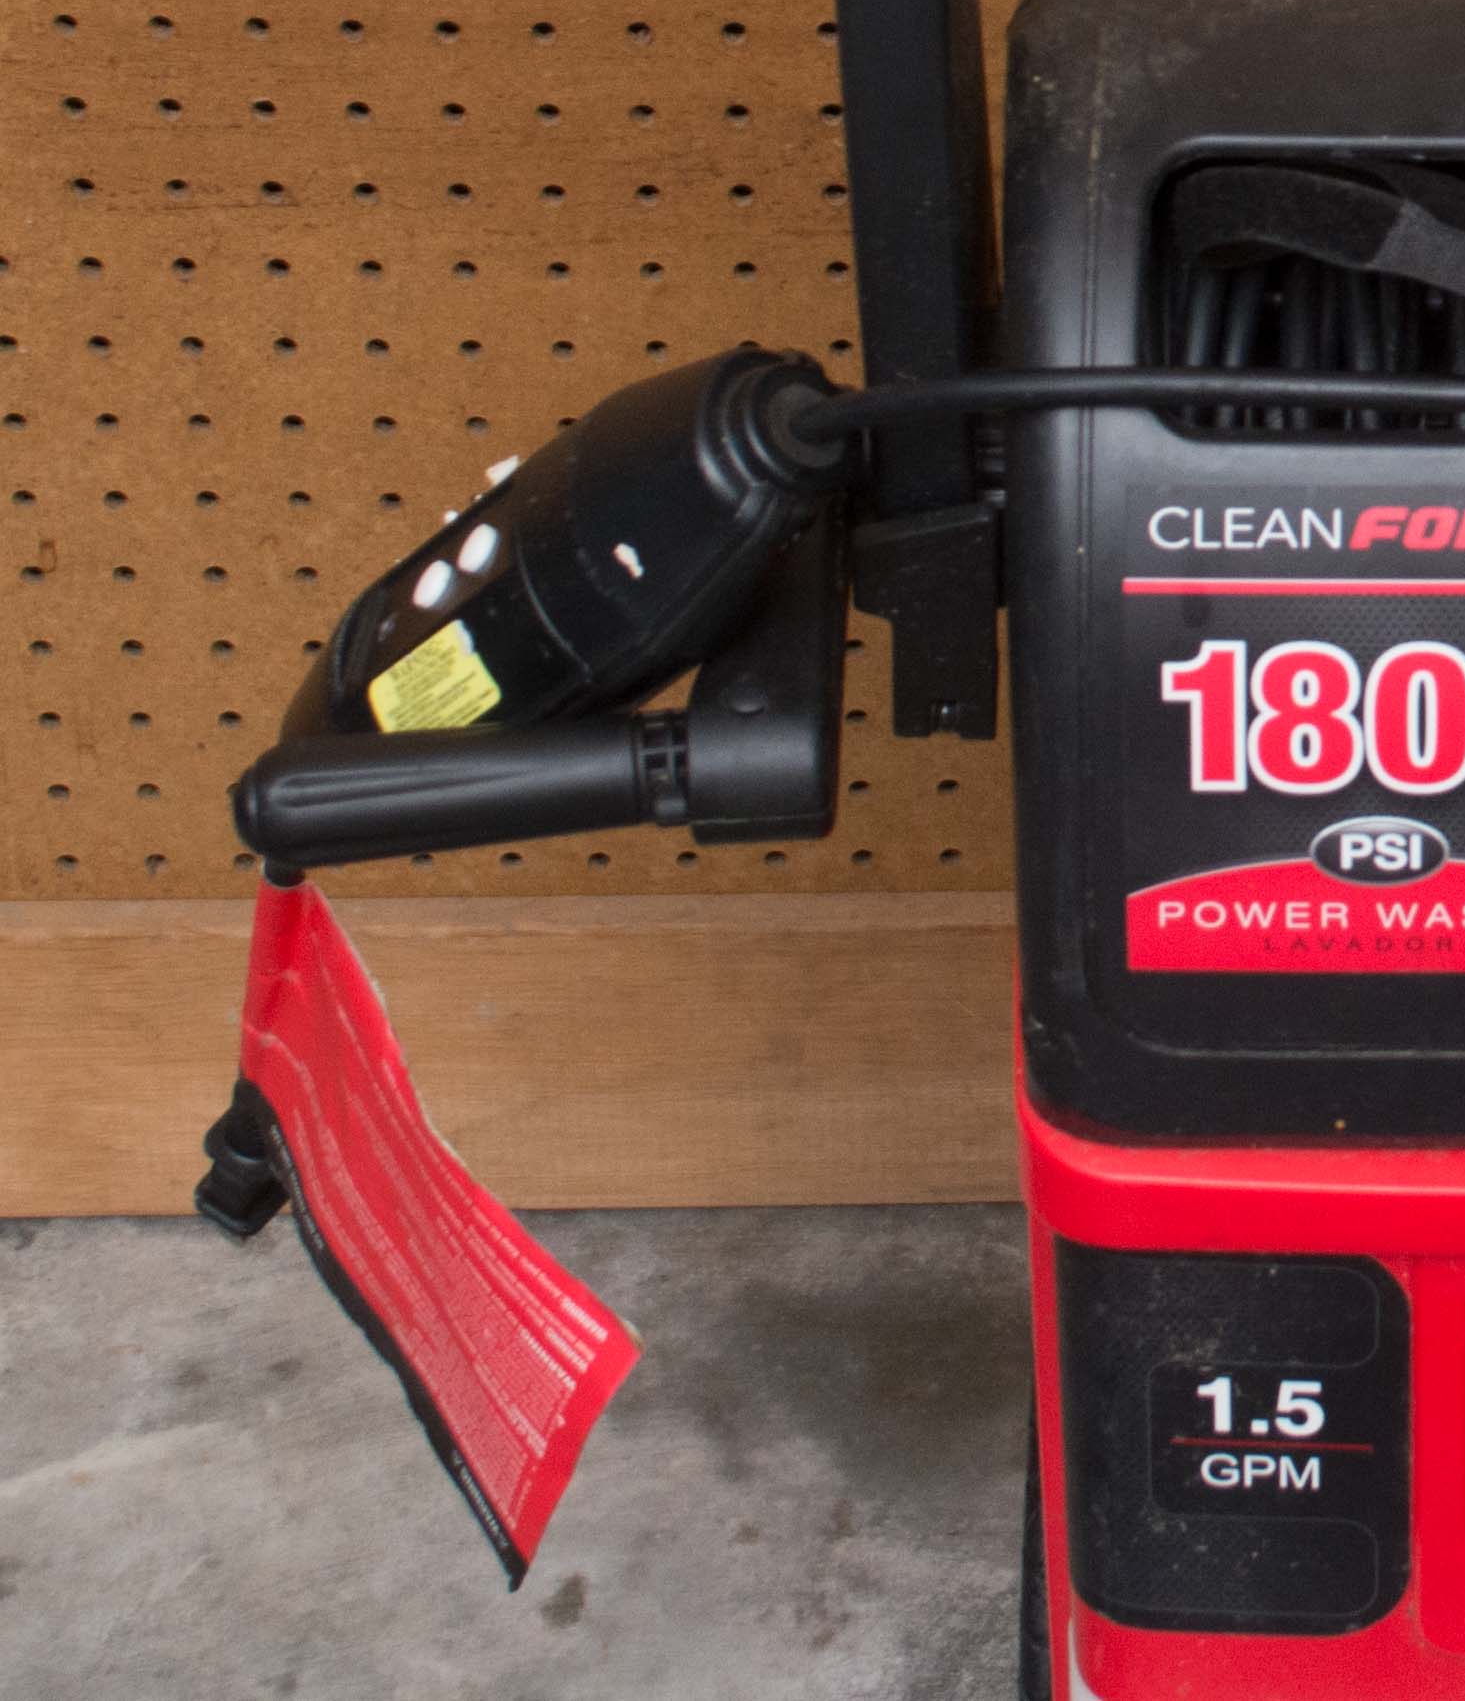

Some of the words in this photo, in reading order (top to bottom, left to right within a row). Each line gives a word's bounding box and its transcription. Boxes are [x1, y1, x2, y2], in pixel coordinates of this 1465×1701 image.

[1339, 832, 1423, 870] PSI
[1157, 902, 1350, 930] POWER
[1197, 1376, 1325, 1437] 1.5
[1201, 1453, 1321, 1491] GPM
